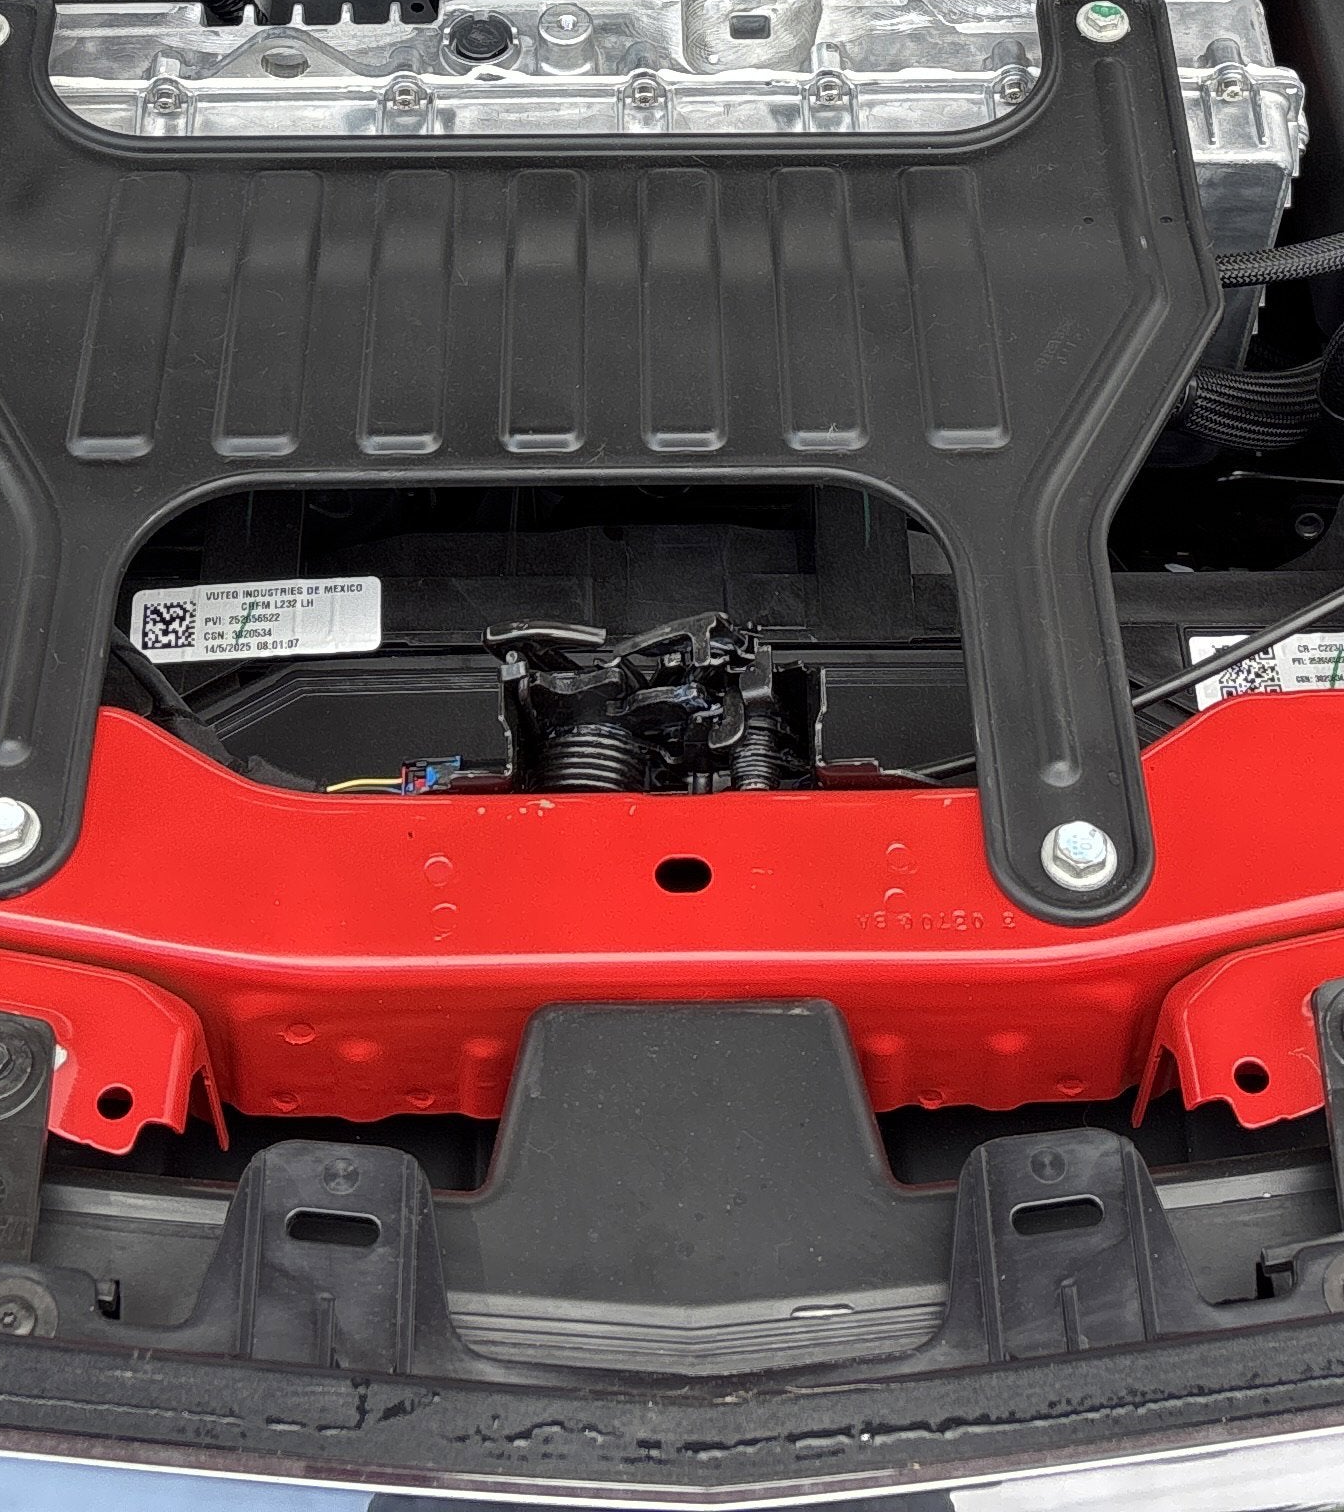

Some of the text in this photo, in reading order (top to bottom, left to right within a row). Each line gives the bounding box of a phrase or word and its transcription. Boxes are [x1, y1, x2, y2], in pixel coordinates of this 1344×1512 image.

[206, 583, 363, 601] VUTEQ INDUSTRIES DE MEXICO
[274, 598, 297, 610] L232
[300, 597, 314, 608] LH
